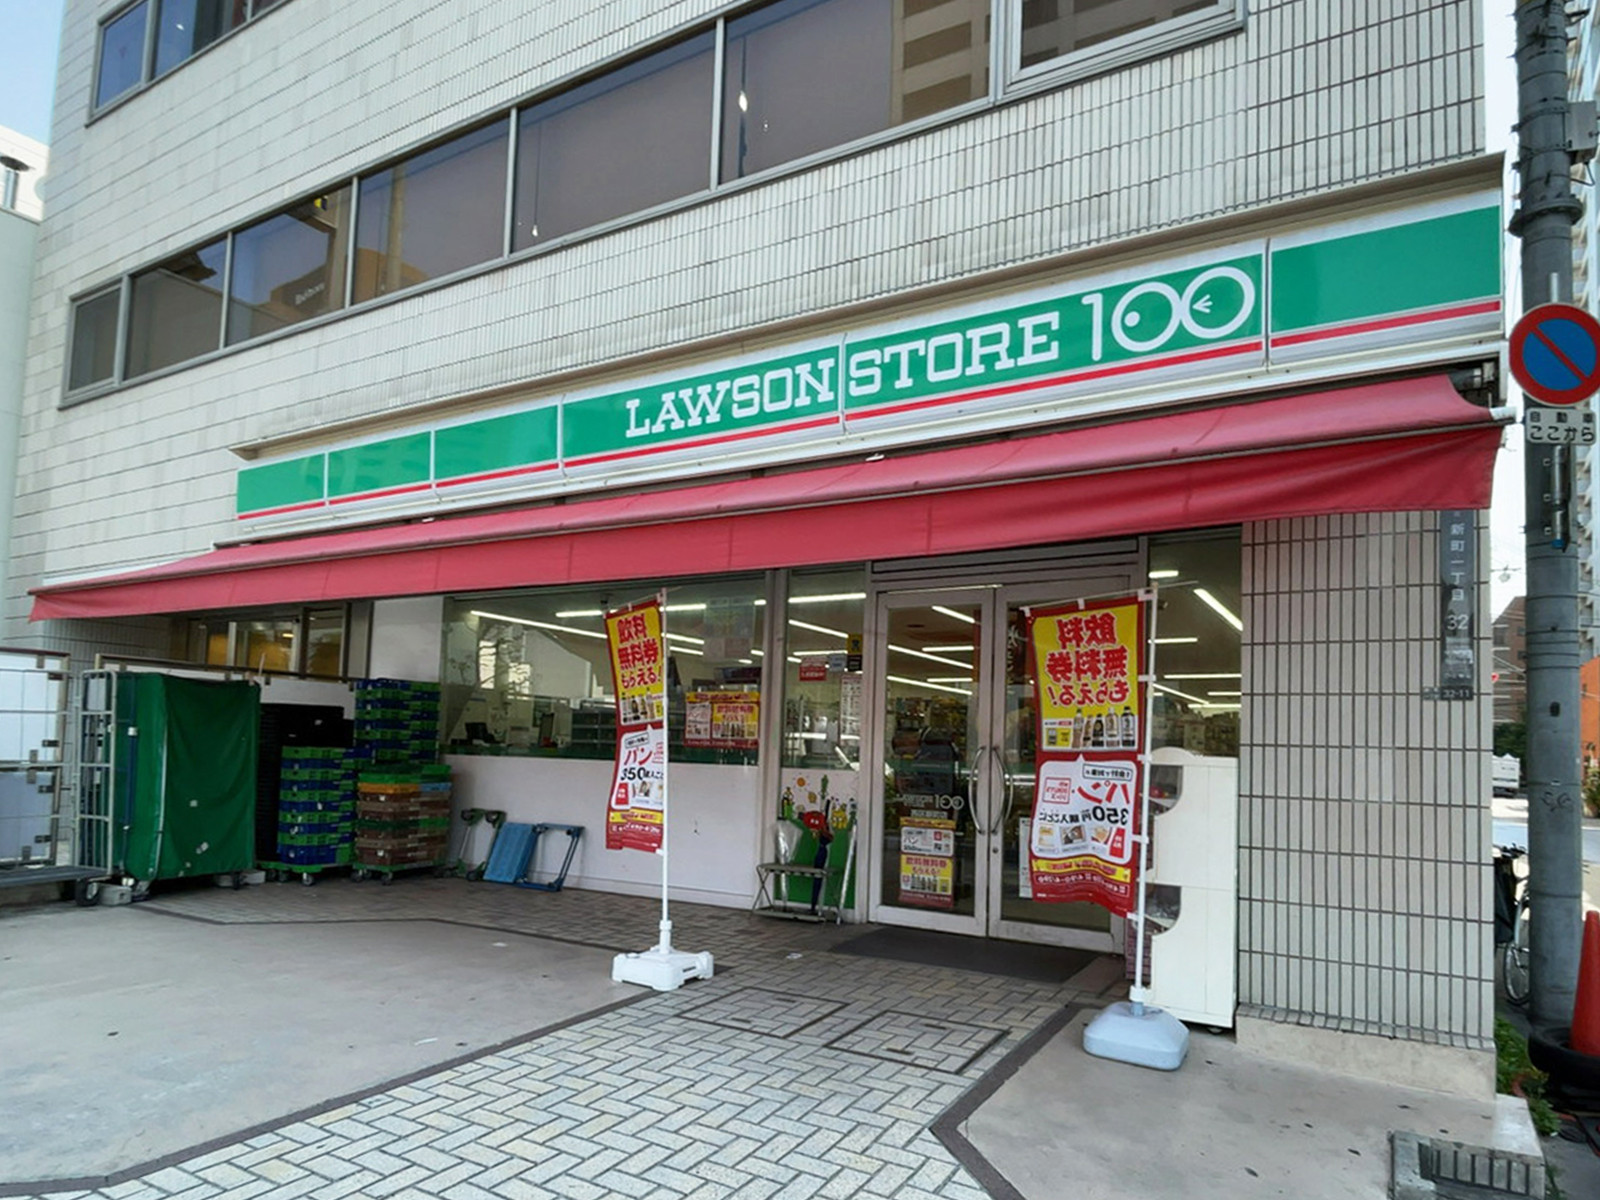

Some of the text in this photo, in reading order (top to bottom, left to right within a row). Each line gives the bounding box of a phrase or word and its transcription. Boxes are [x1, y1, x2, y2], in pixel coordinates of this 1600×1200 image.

[625, 266, 1256, 438] LAWSON STORE 100
[1529, 425, 1595, 442] ここから
[1446, 614, 1469, 631] 32
[624, 746, 653, 766] パン
